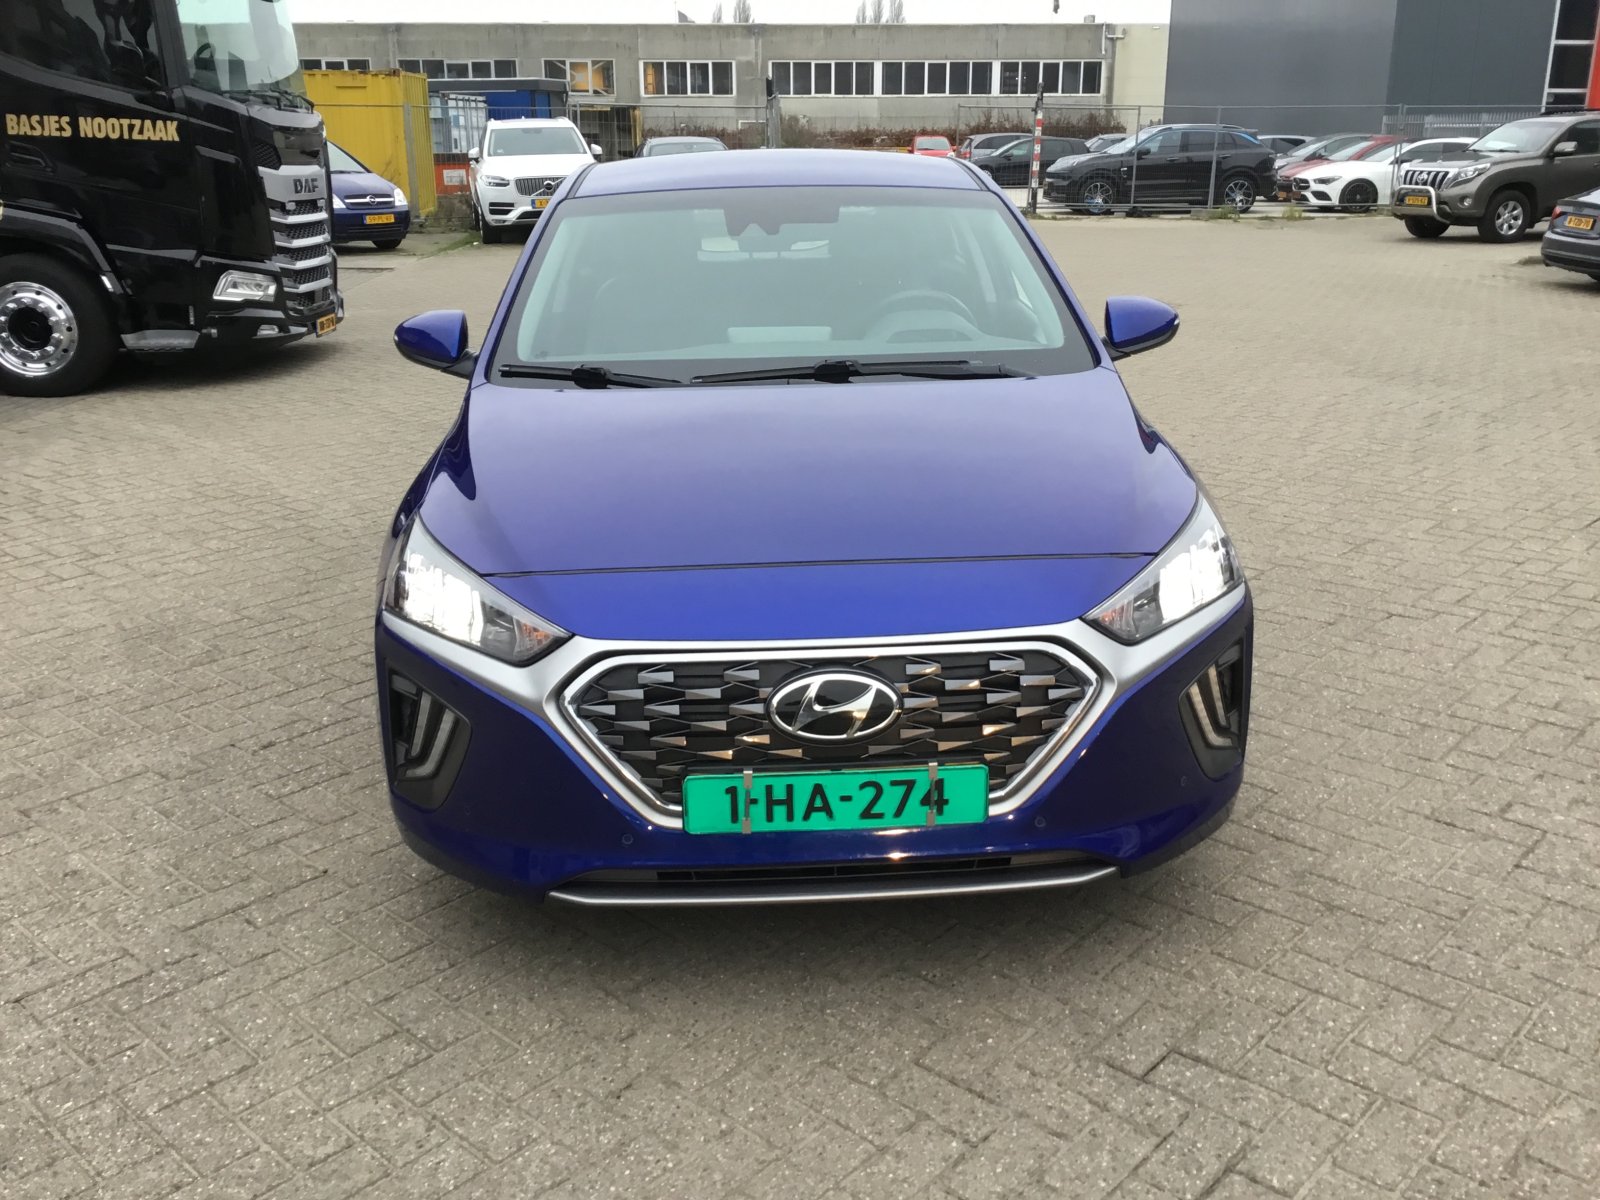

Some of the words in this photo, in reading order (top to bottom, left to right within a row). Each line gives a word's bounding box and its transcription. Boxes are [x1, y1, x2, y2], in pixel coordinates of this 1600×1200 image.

[5, 113, 72, 137] BASJES
[78, 116, 180, 142] NOOTZAAK
[293, 178, 319, 194] DAF
[724, 777, 950, 825] 1-HA-274
